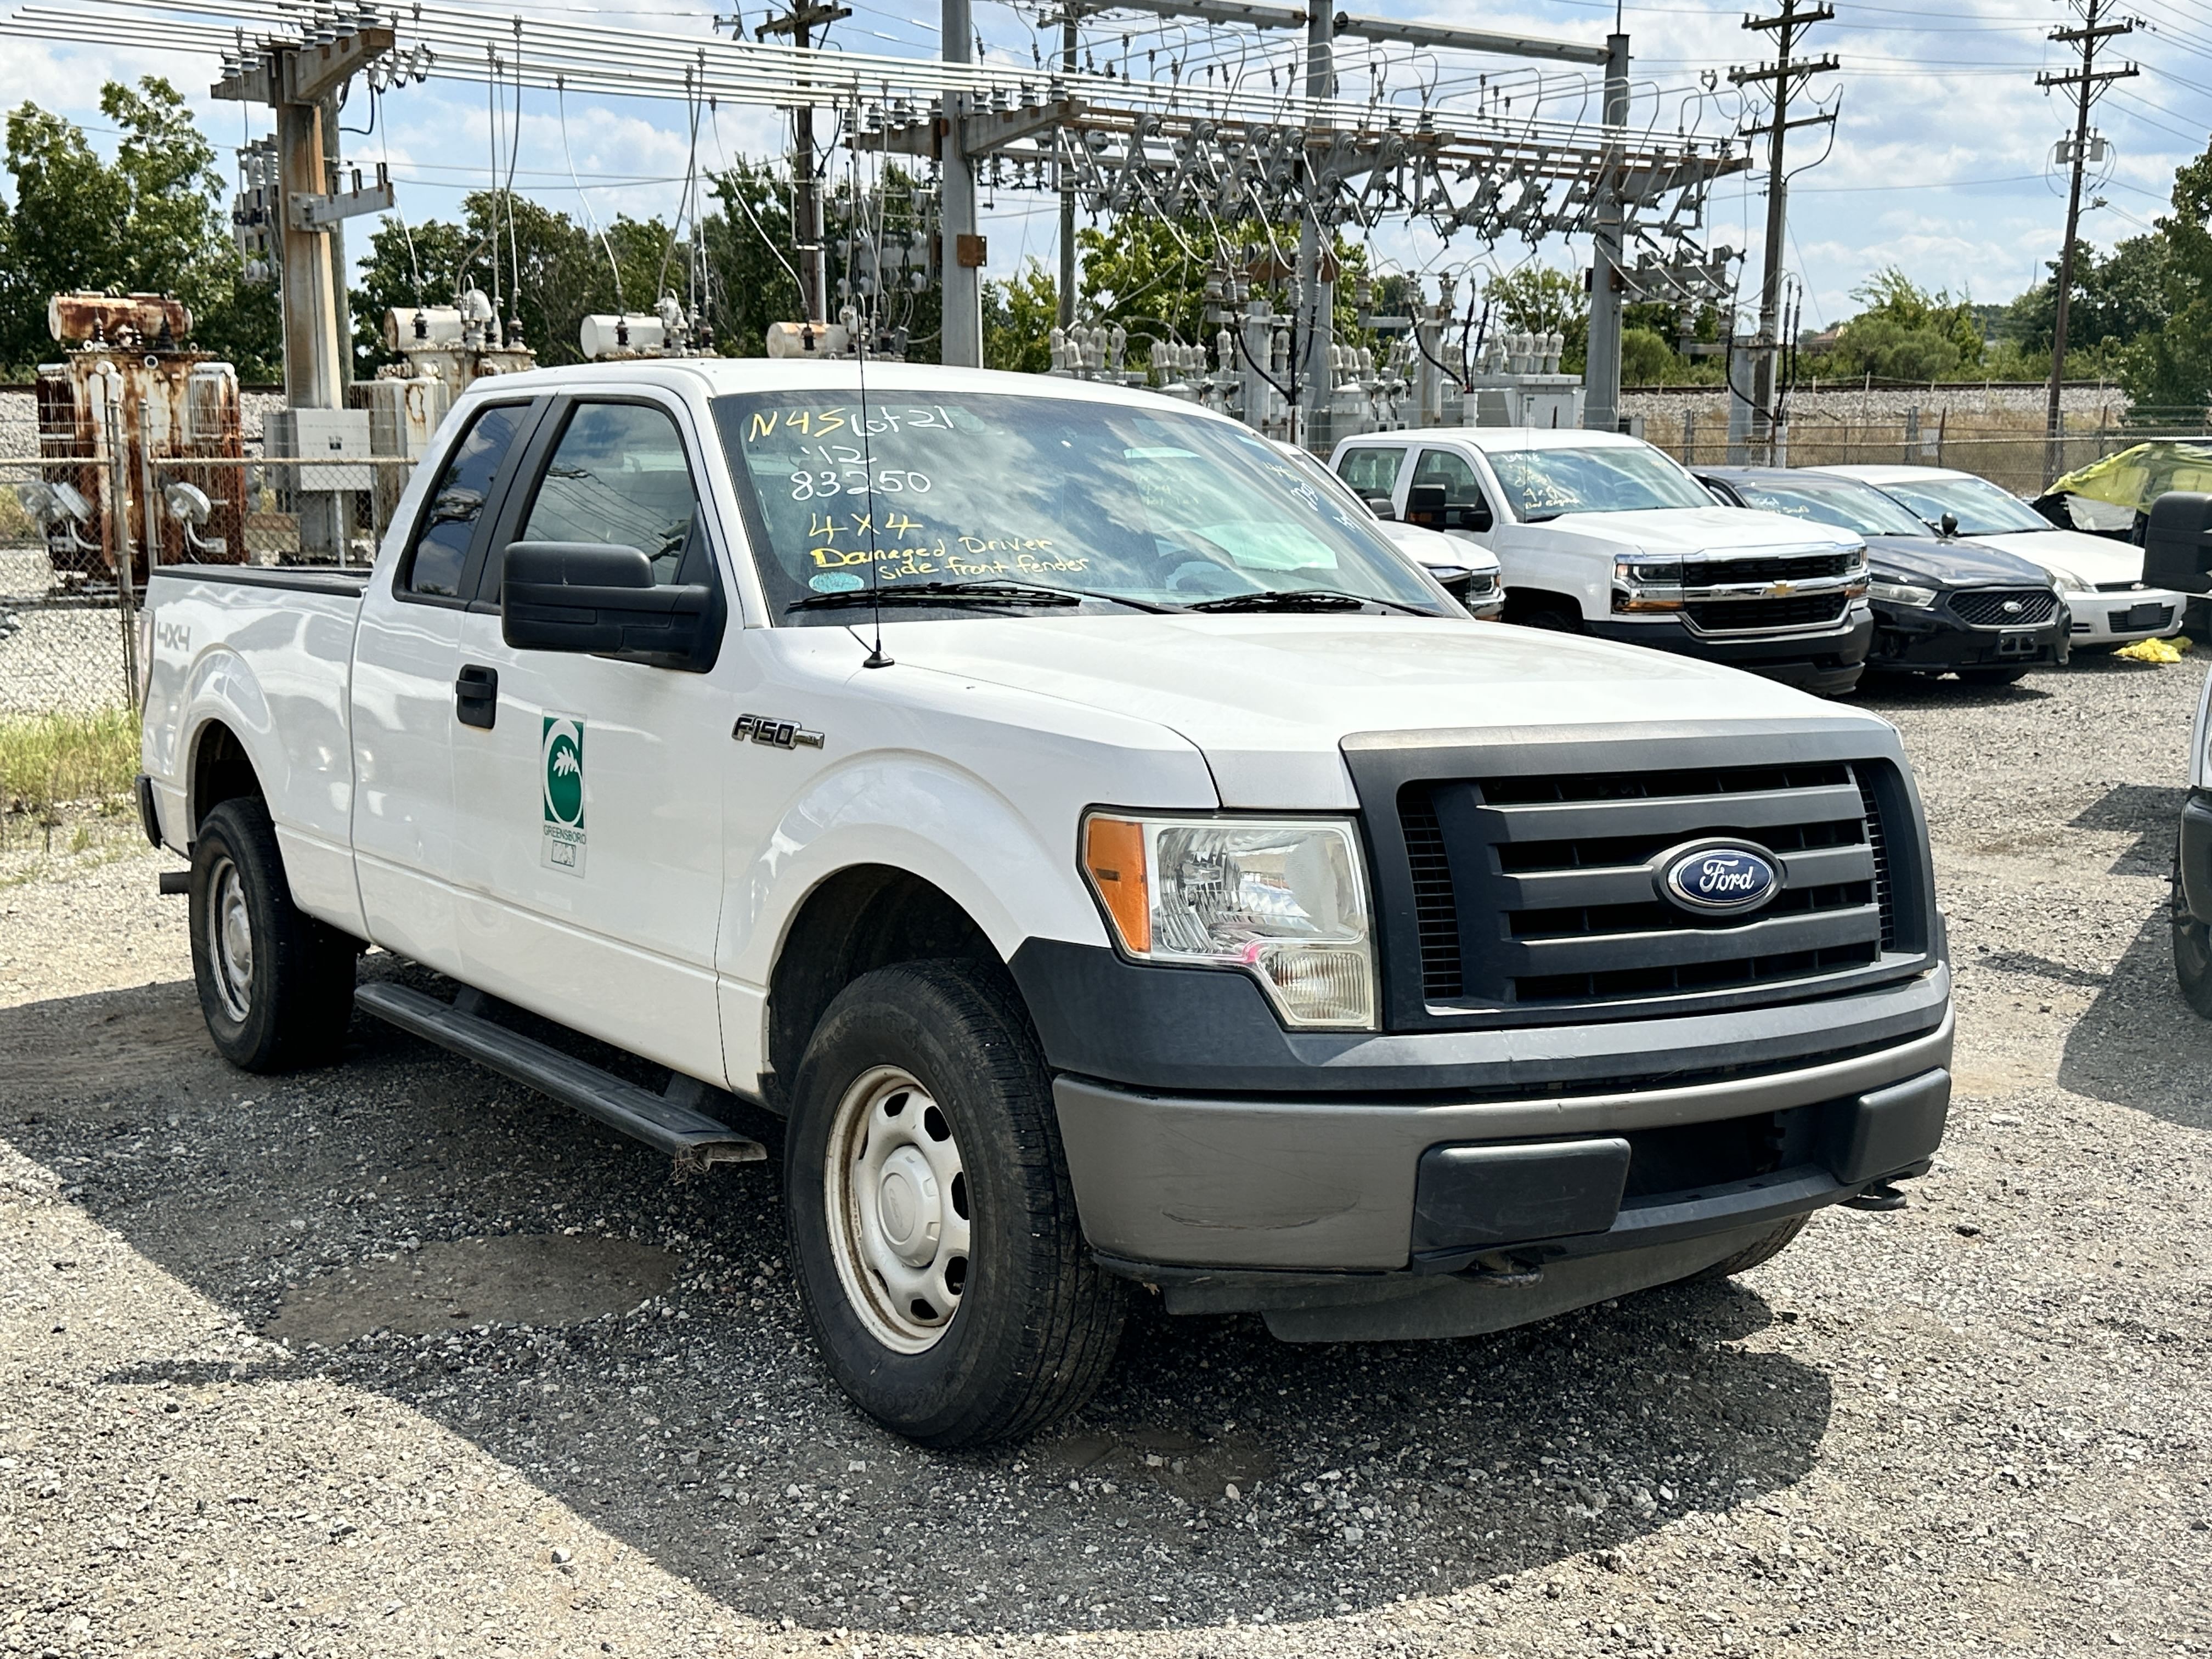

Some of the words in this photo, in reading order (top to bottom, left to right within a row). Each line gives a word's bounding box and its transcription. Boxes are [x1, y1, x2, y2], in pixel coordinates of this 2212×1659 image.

[850, 406, 901, 437] Lot
[907, 405, 955, 430] 21
[790, 470, 932, 501] 83250
[810, 539, 946, 568] Damaged
[958, 536, 1053, 554] Driver
[945, 556, 1011, 576] front
[1016, 554, 1090, 574] fender
[543, 824, 586, 845] GREENSBORO
[1699, 859, 1755, 893] Ford
